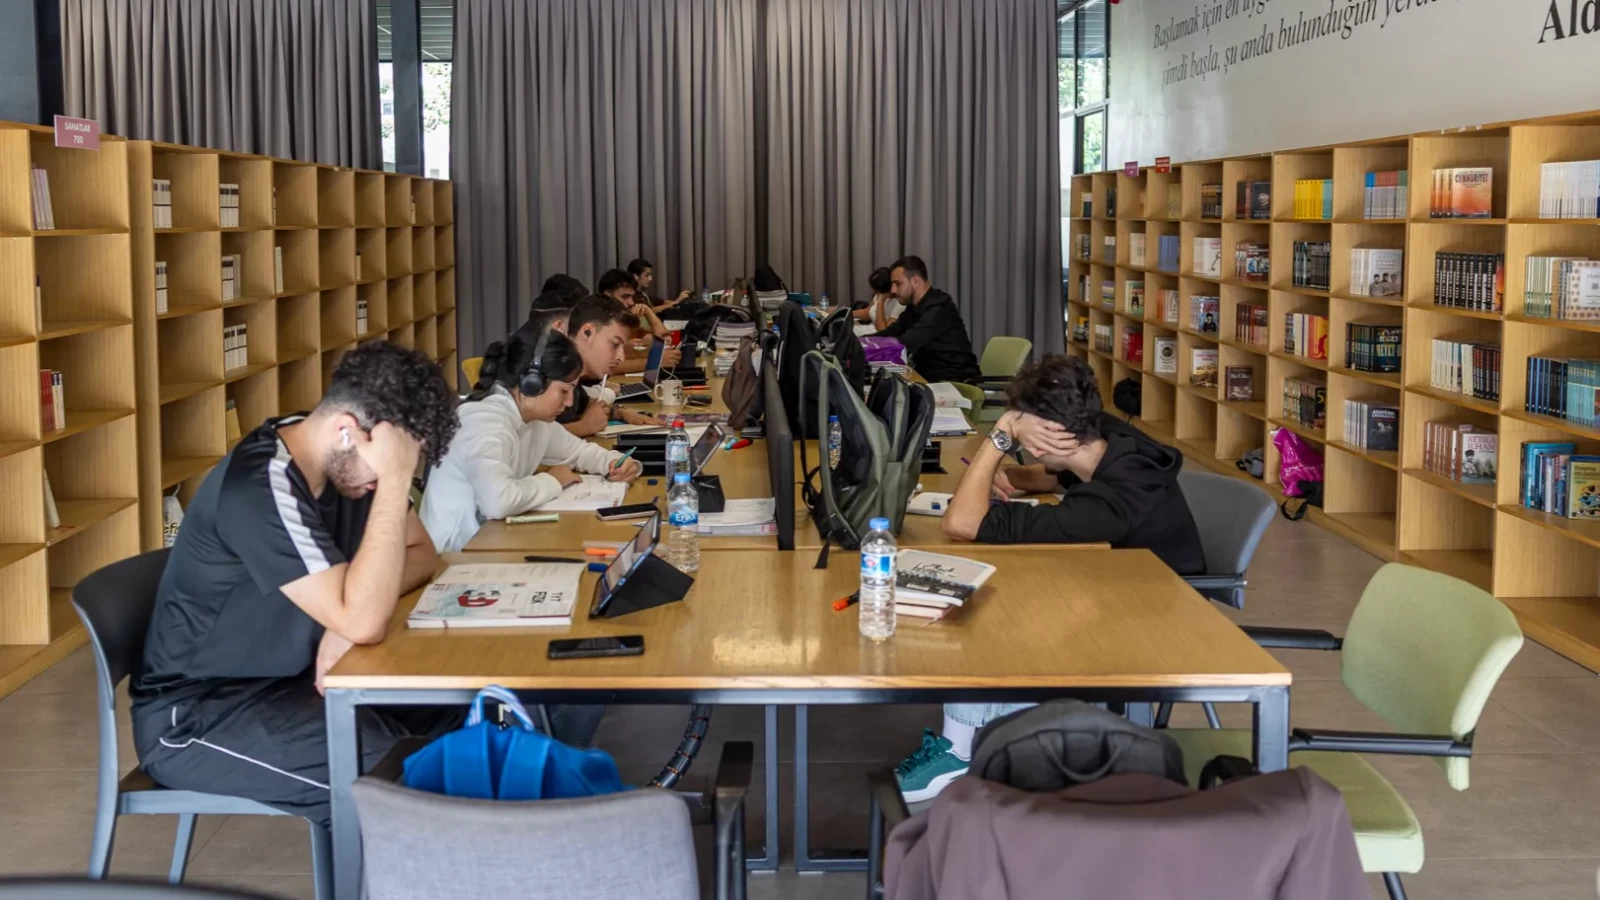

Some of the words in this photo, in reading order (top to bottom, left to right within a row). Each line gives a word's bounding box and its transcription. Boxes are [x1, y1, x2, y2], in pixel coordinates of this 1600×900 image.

[1153, 6, 1200, 51] Başlamak
[1202, 0, 1222, 35] için
[1225, 0, 1239, 19] en
[1242, 0, 1273, 18] uyg
[1160, 53, 1188, 92] şimdi
[1190, 44, 1220, 81] başla,
[1224, 45, 1238, 74] şu
[1240, 23, 1274, 61] anda
